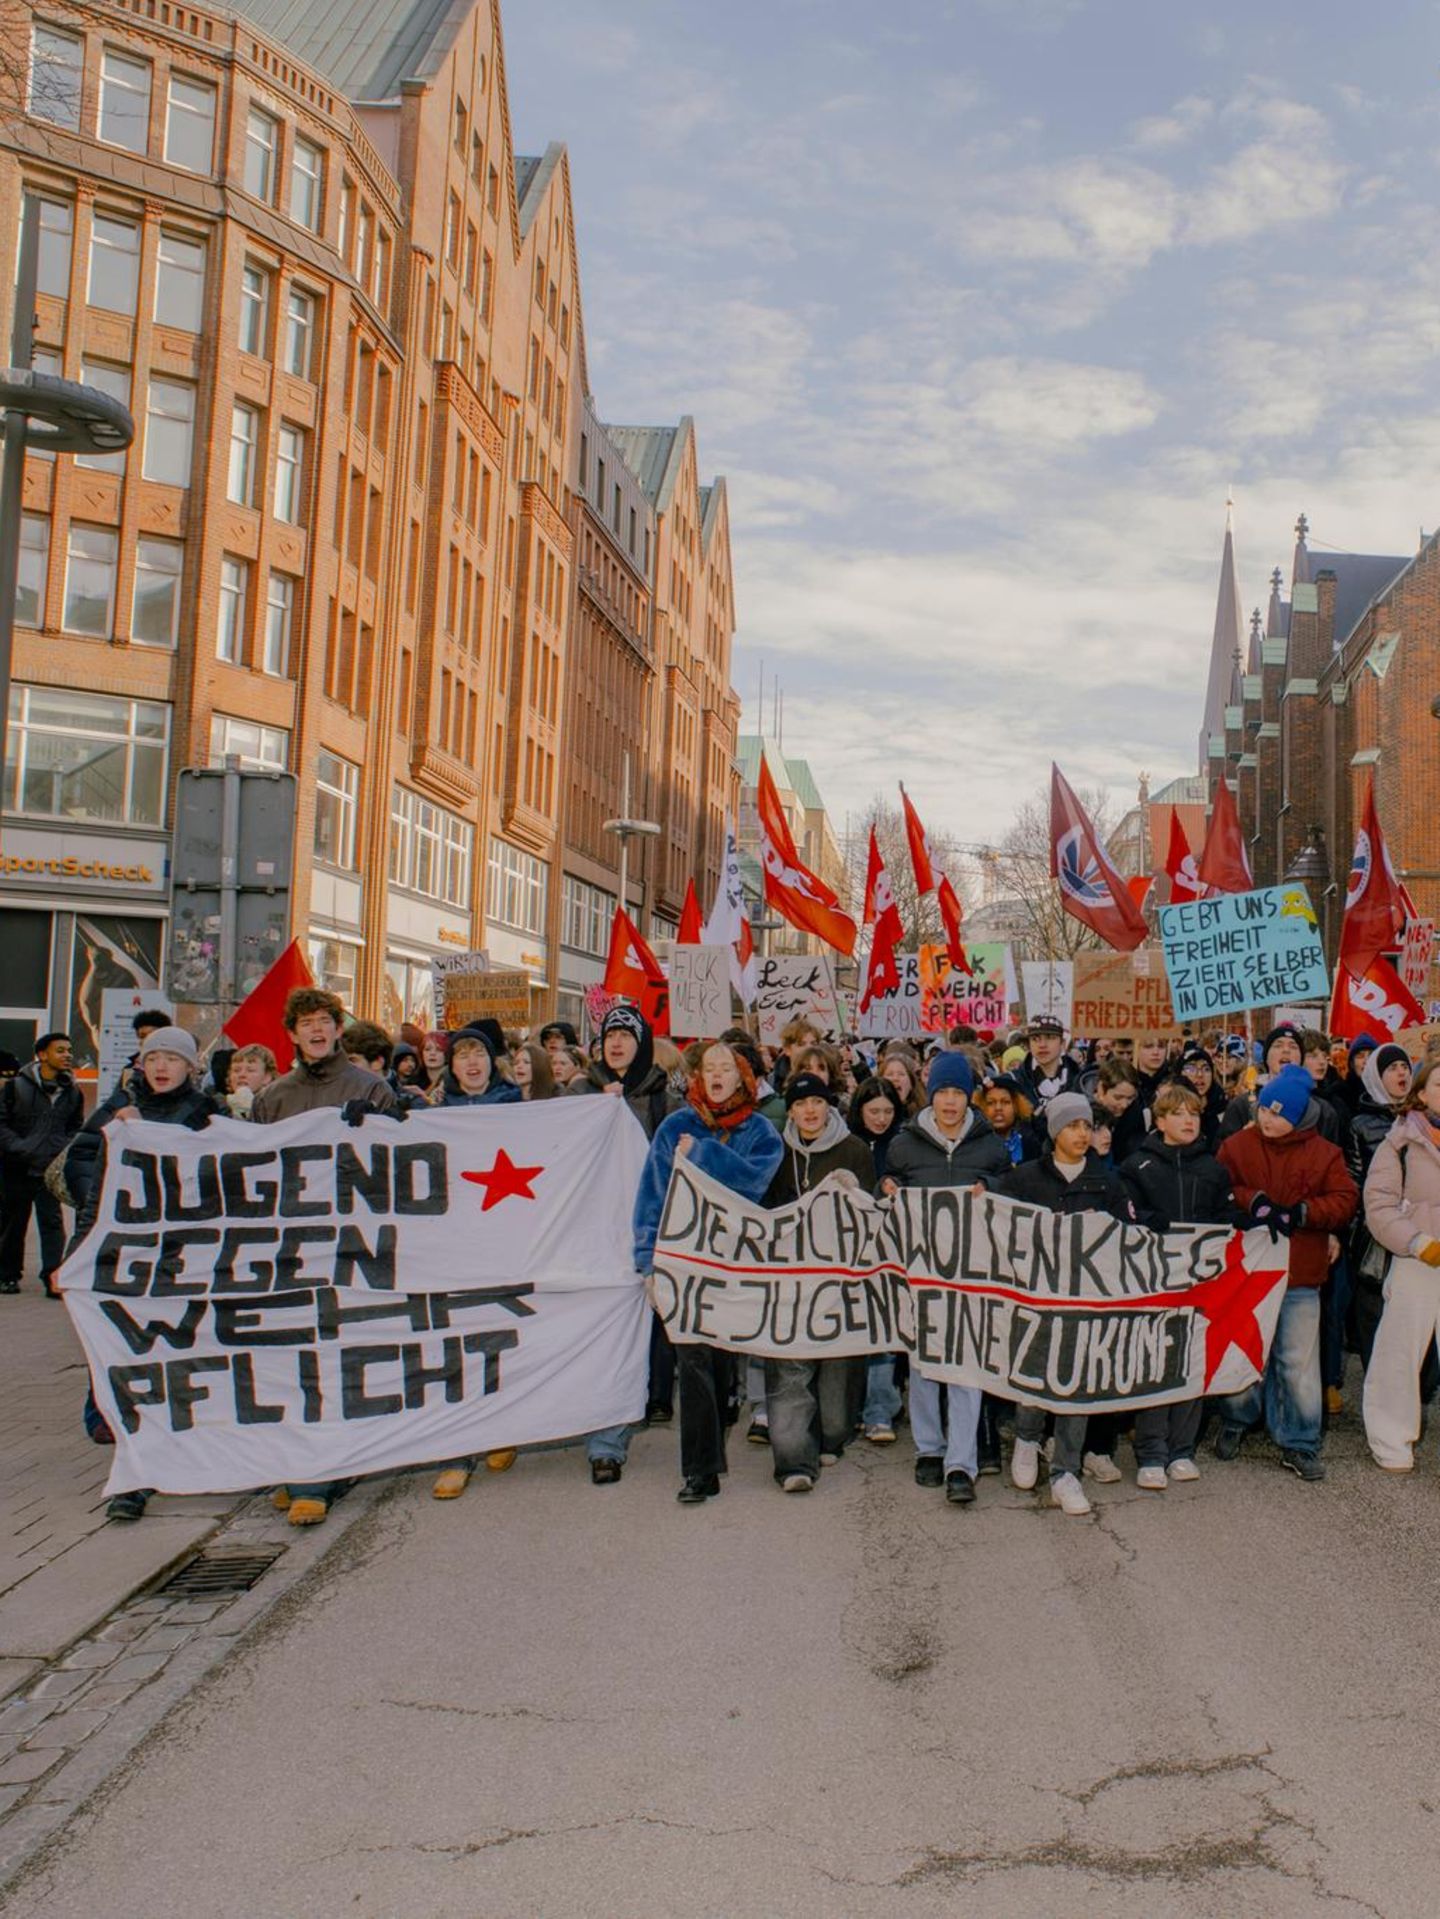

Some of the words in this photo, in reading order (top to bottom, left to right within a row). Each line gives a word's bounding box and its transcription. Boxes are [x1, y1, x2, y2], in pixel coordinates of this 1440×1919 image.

[1162, 900, 1223, 937] GEBT
[1235, 891, 1277, 921] UNS
[675, 950, 718, 986] FICK
[1165, 925, 1267, 966] FREIHEIT
[1171, 960, 1236, 989] ZIEHT
[1243, 945, 1322, 978] SELBER
[927, 980, 997, 1000] WEHR
[1179, 989, 1198, 1013] IN
[1204, 981, 1244, 1008] DEN
[1251, 970, 1311, 1001] KRIEG
[929, 1000, 1004, 1027] PFLICHT
[114, 1142, 449, 1224] JUGEND
[659, 1168, 728, 1258] DIE
[733, 1190, 905, 1267] REICHEN
[902, 1188, 1062, 1294] WOLLEN
[1070, 1214, 1231, 1297] KRIEG
[92, 1223, 398, 1297] GEGEN
[99, 1282, 538, 1356] WEHR
[653, 1265, 727, 1338] DIE
[730, 1272, 917, 1351] JUGEND
[918, 1289, 1004, 1375] EINE
[1009, 1306, 1196, 1397] ZUKUNFT
[107, 1328, 519, 1435] PFLICHT
